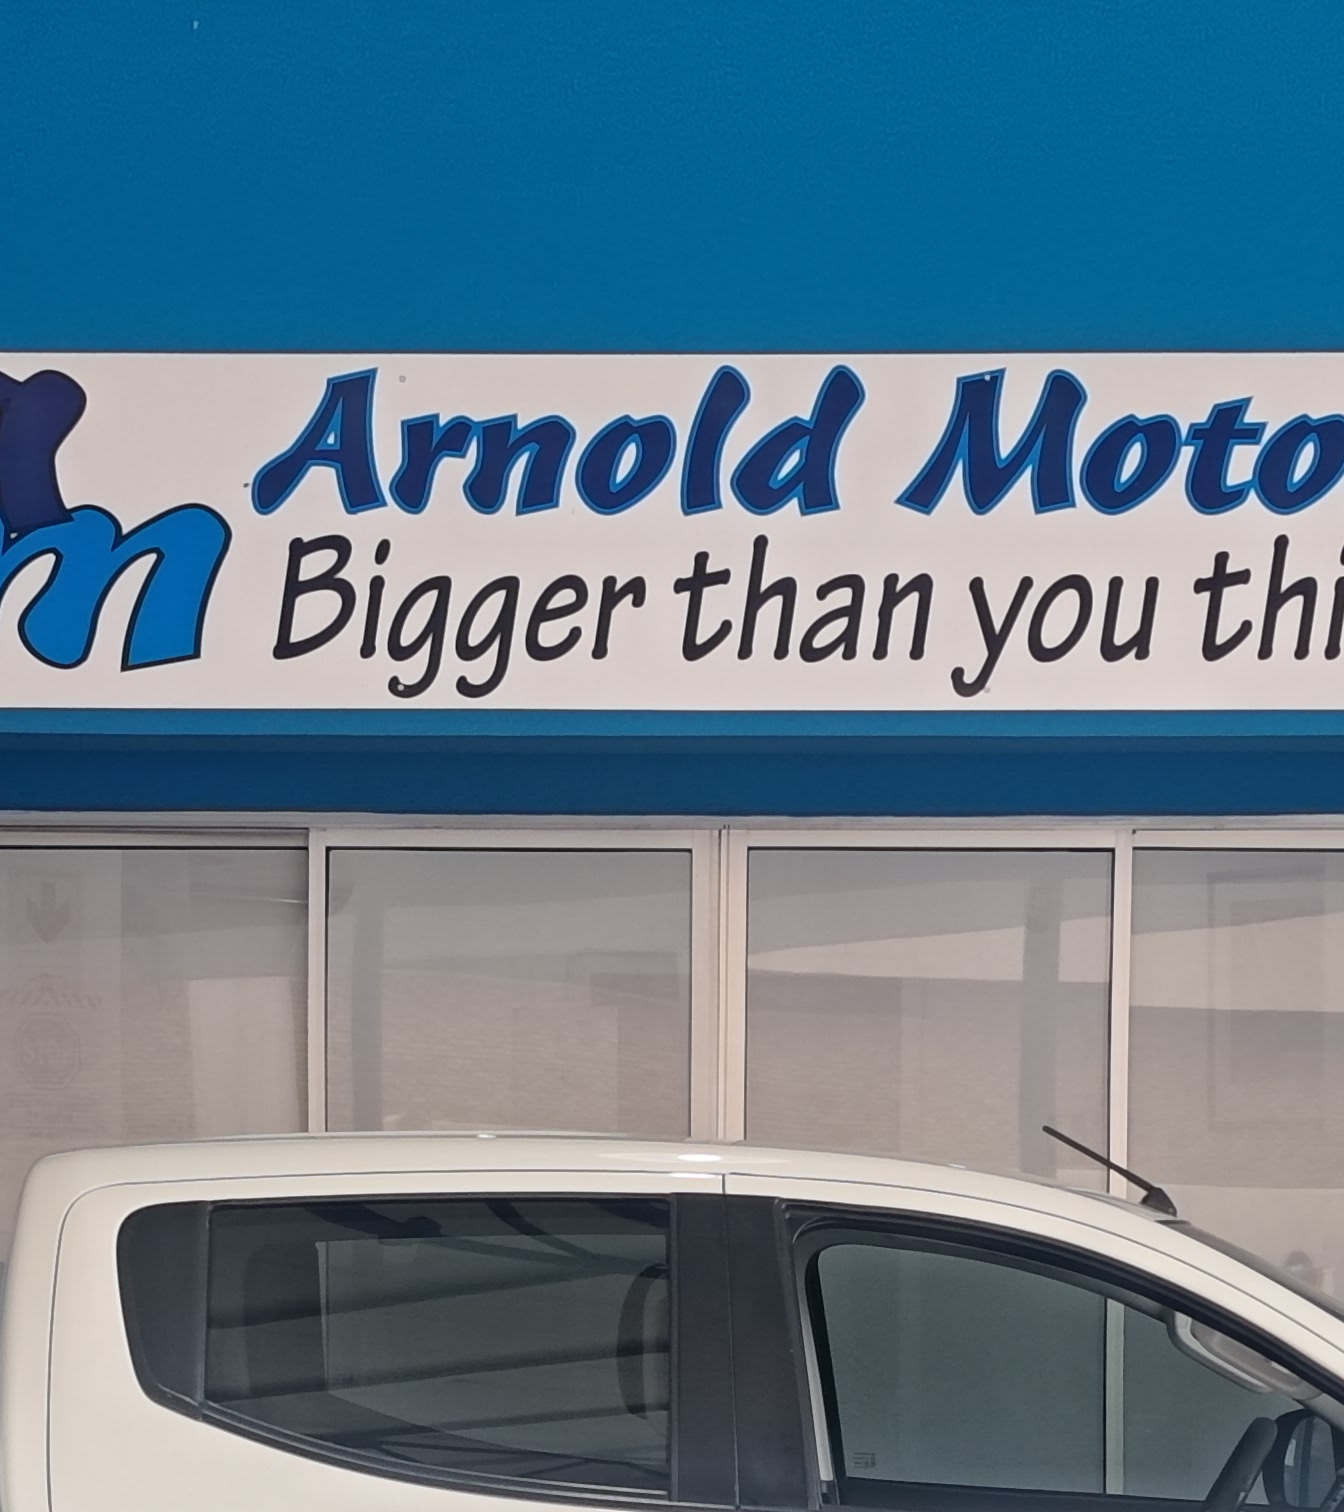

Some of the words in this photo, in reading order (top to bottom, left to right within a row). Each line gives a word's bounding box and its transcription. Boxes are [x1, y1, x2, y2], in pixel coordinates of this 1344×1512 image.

[250, 364, 866, 517] Arnold
[272, 533, 647, 699] Bigger
[672, 533, 935, 662] than
[949, 574, 1161, 698] you
